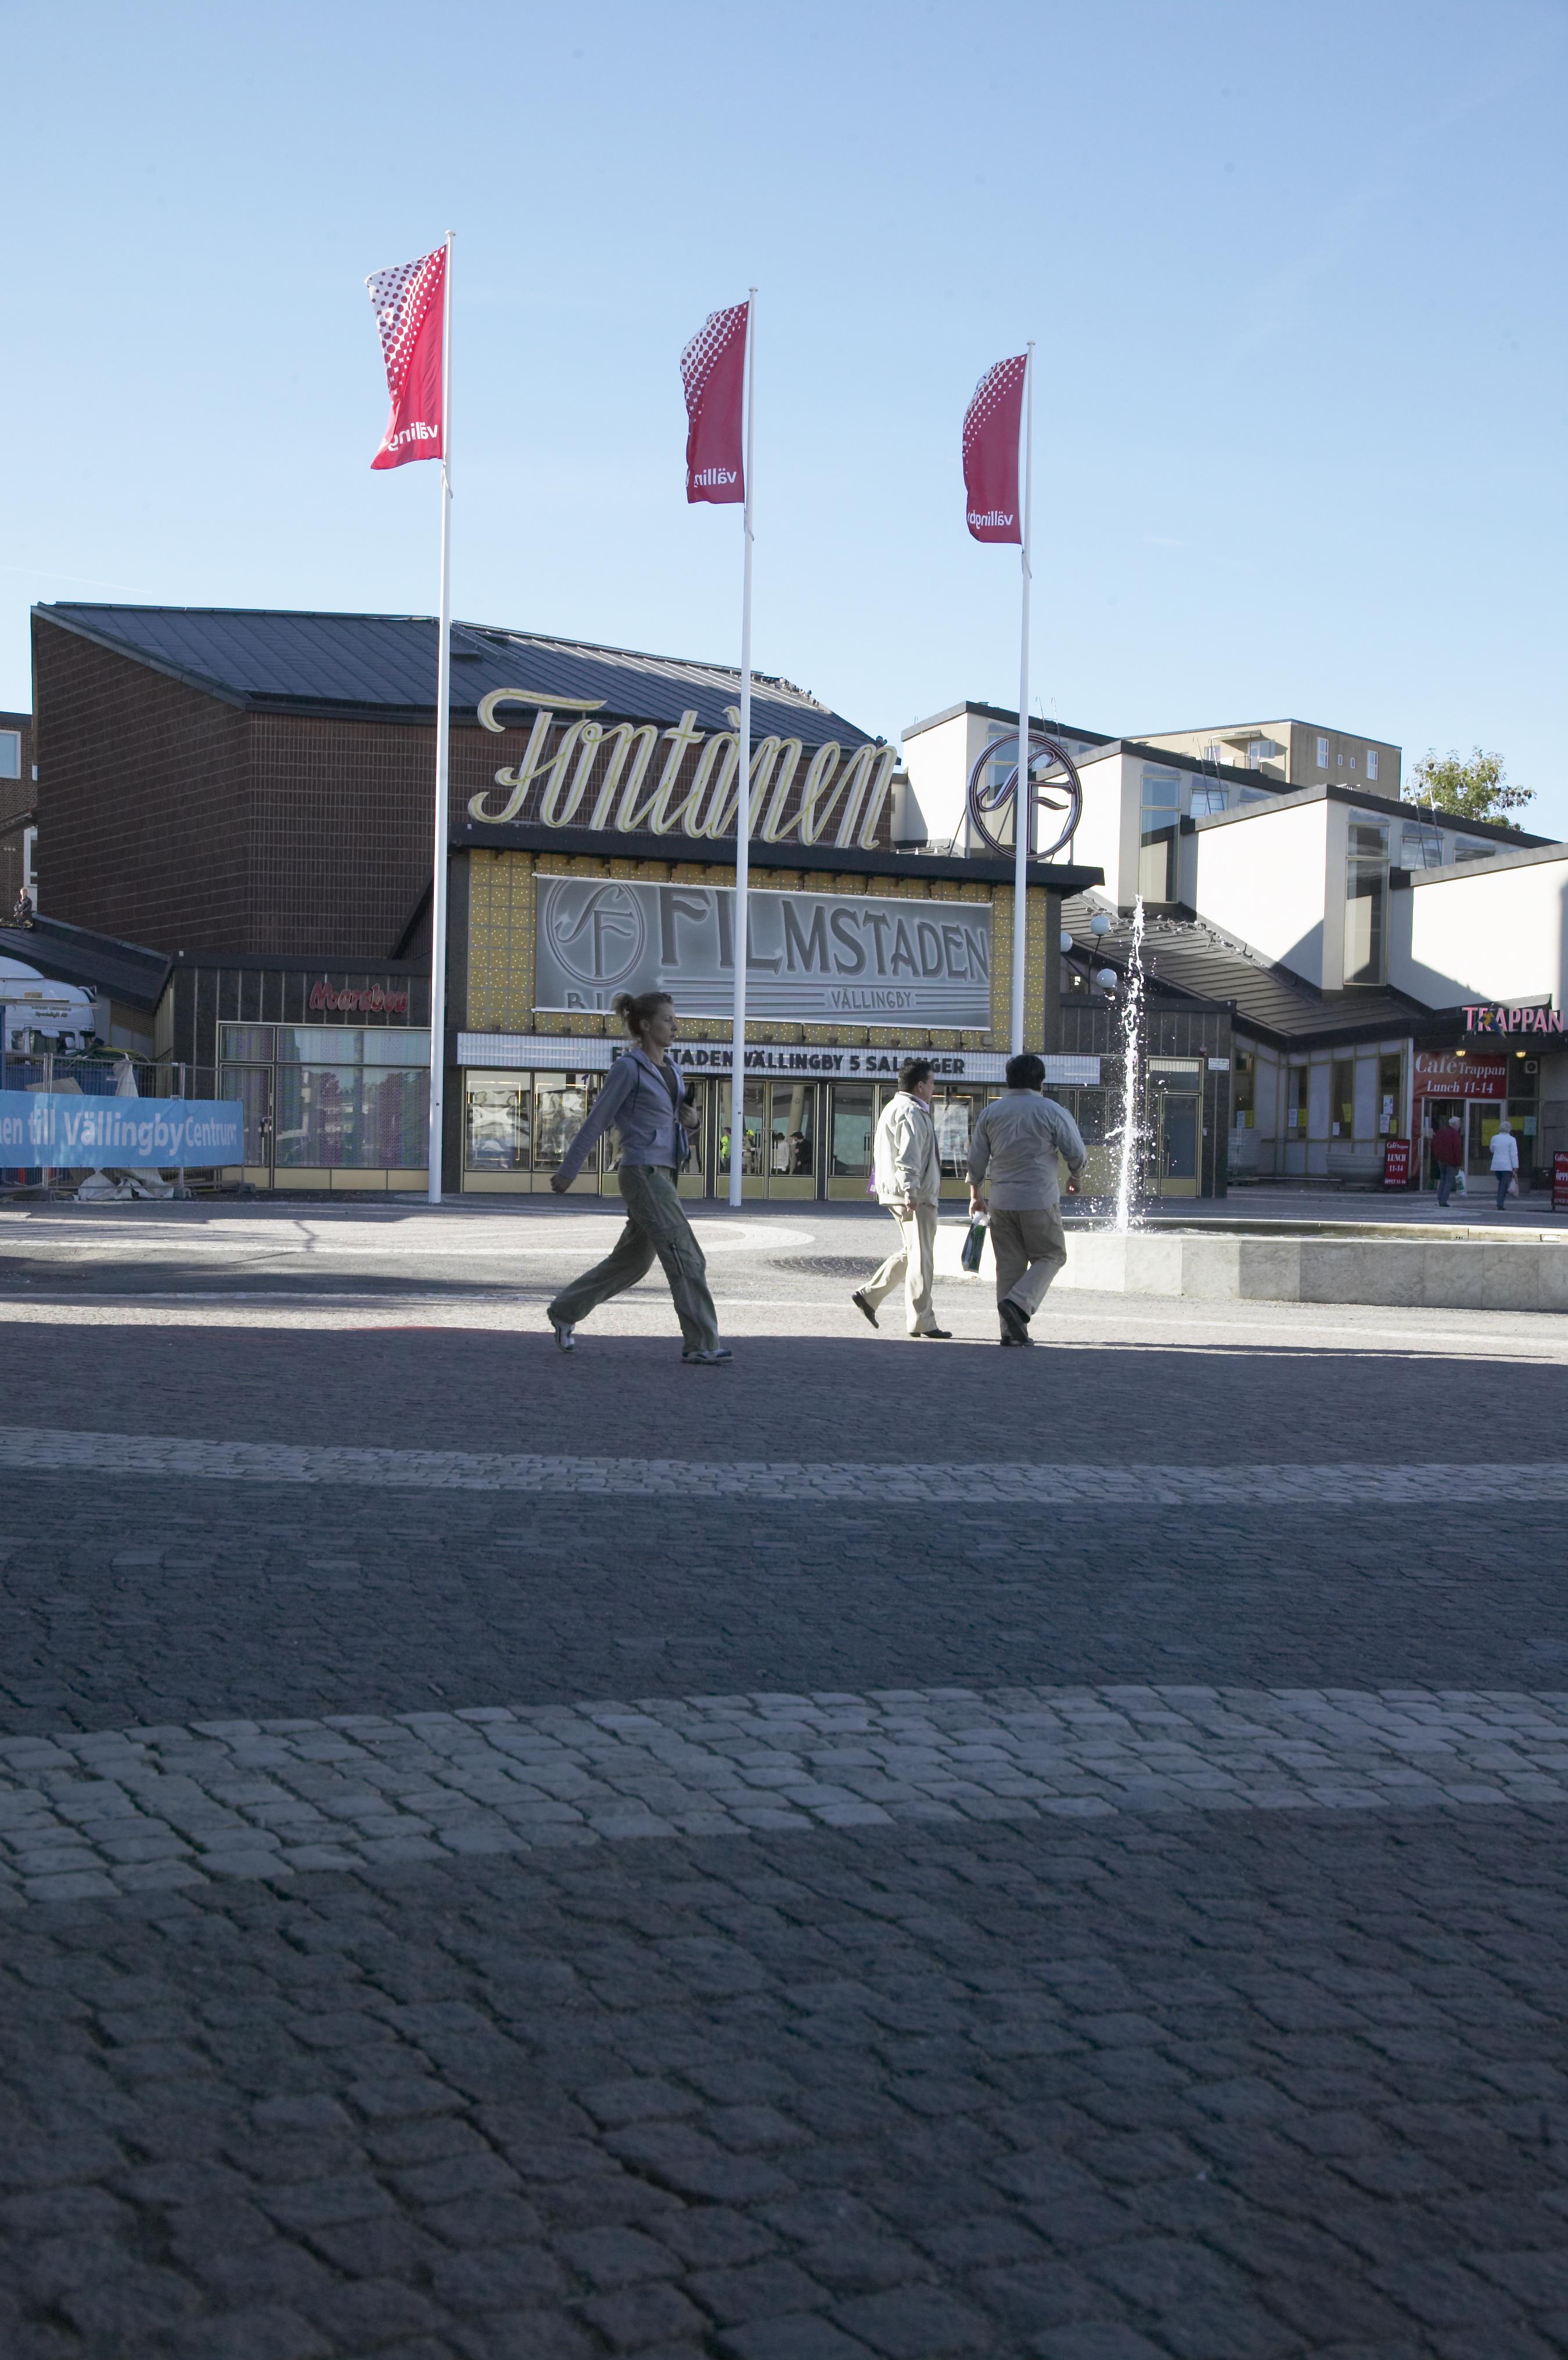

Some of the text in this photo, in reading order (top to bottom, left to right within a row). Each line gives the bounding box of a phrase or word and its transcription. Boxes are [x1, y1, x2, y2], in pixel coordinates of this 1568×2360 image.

[659, 886, 989, 981] FILMSTADEN
[309, 981, 408, 1013] Marabou
[567, 992, 635, 1009] BI
[831, 988, 911, 1009] VÄLLINGBY
[1462, 1007, 1563, 1032] TRAPPAN
[744, 1051, 843, 1071] VÄLLINGBY
[850, 1056, 861, 1071] 5
[866, 1056, 965, 1074] SALGER
[1415, 1053, 1505, 1078] Café Trappan
[1427, 1080, 1494, 1093] Lunch 11-14
[28, 1109, 55, 1145] till
[64, 1110, 184, 1156] Vällingby
[1387, 1153, 1407, 1161] LUNCH
